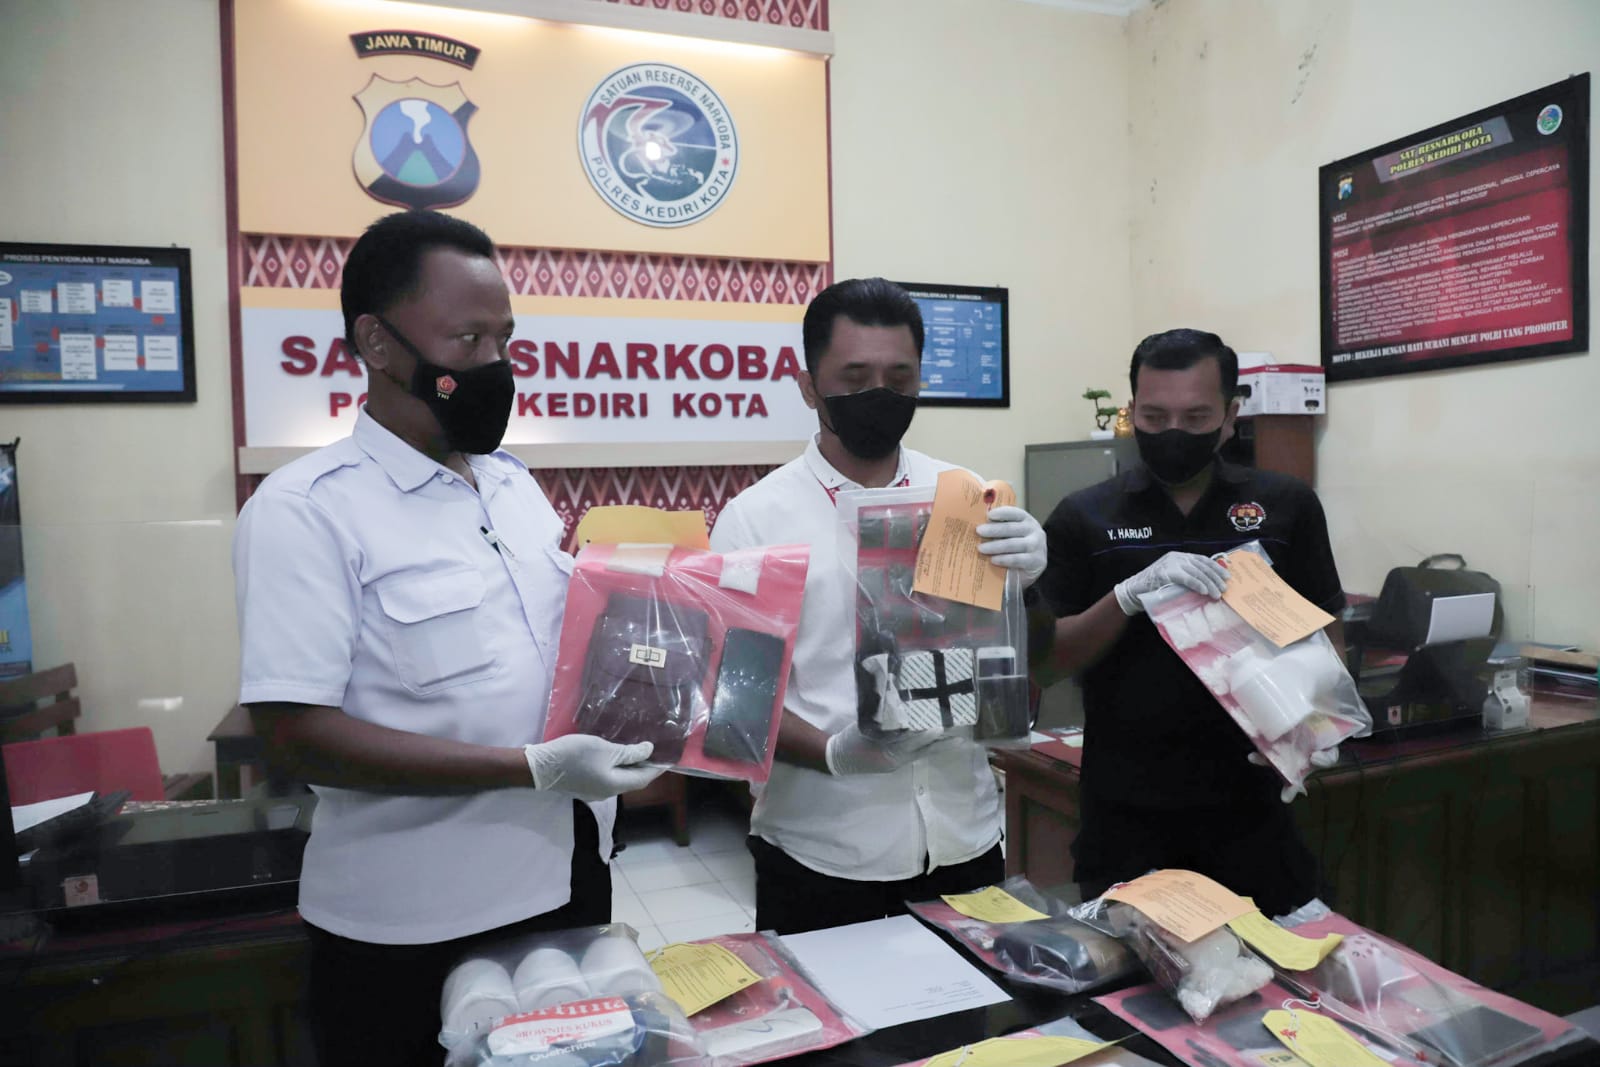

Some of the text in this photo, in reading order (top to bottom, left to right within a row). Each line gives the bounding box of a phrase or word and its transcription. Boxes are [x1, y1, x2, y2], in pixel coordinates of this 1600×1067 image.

[365, 35, 467, 60] JAWA TIMUR
[601, 69, 731, 150] SATUAN RESERSE NARKOBA
[1390, 134, 1492, 175] POLRES KEDIRI KOTA
[1400, 126, 1483, 160] SAT RESNARKOBA
[592, 156, 729, 218] POLRES KEDIRI KOTA
[3, 253, 41, 263] PROSES
[1480, 330, 1502, 341] POLRI
[1503, 326, 1523, 337] YANG
[1524, 320, 1568, 335] PROMOTER
[281, 335, 801, 382] SA SNARKOBA
[517, 392, 769, 418] KEDIRI KOTA
[1107, 526, 1153, 541] Y. HARIADI
